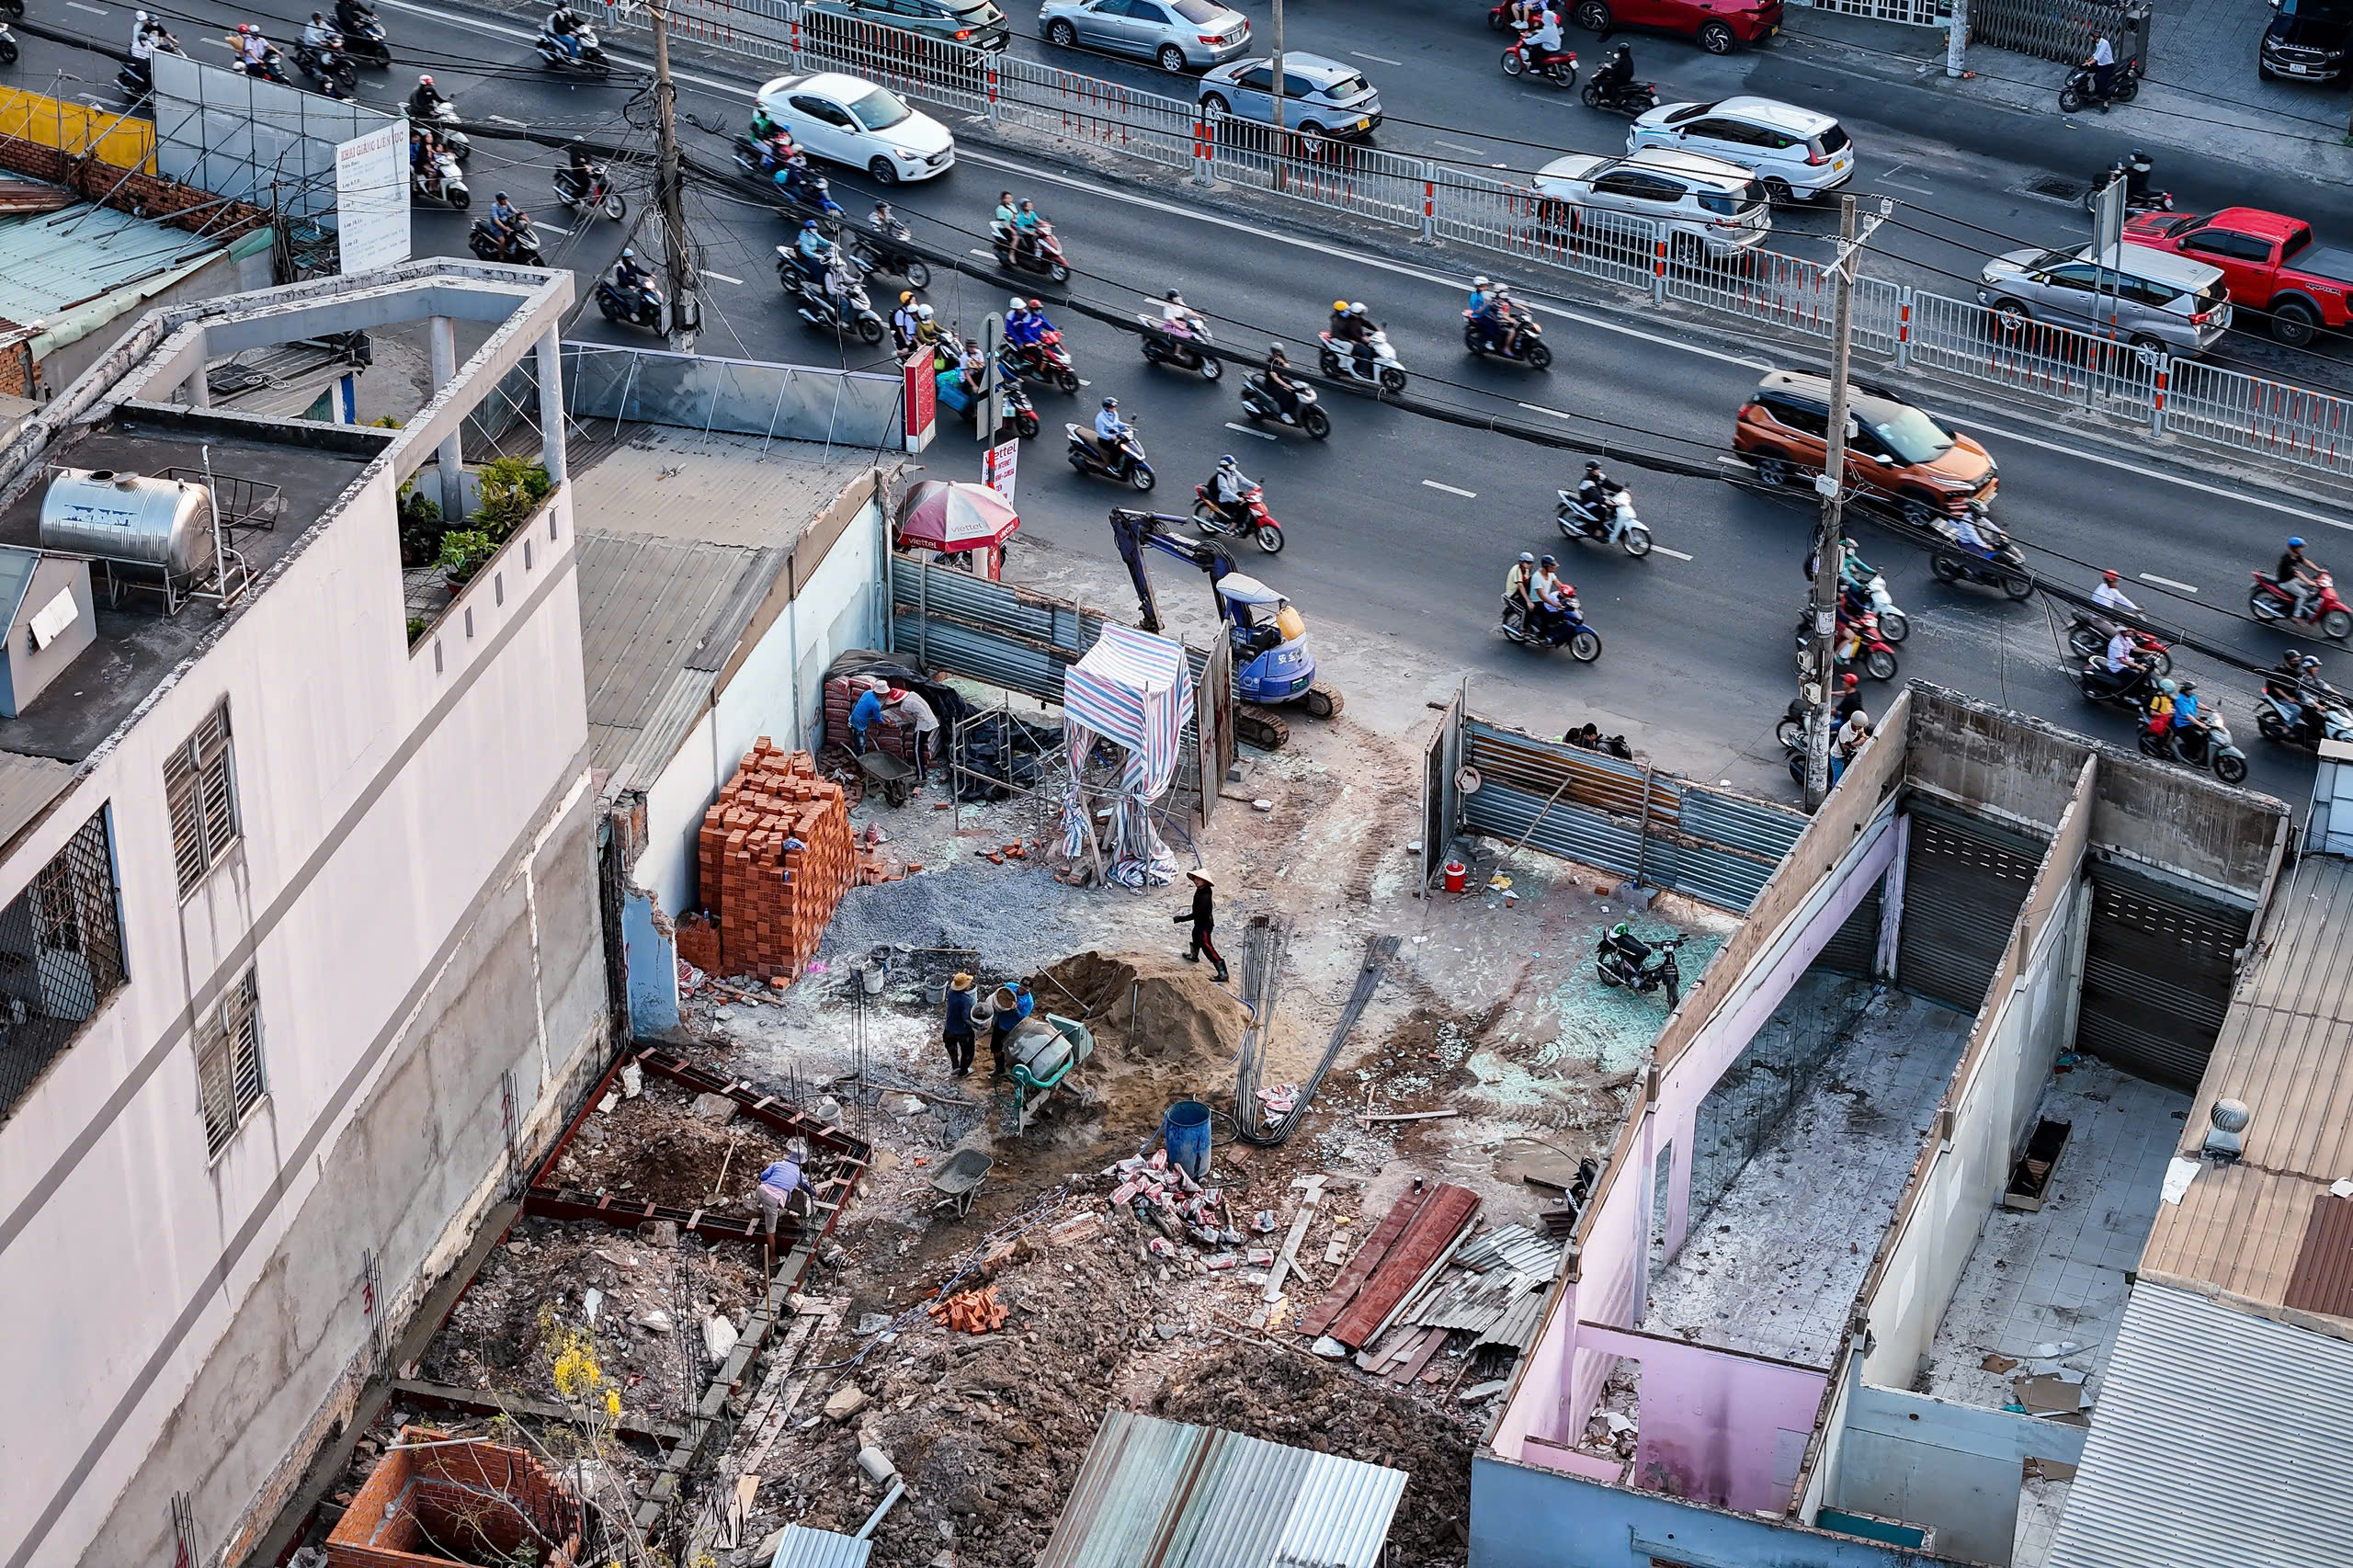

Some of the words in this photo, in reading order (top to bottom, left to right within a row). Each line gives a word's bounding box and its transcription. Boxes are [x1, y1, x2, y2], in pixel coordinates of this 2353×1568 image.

[341, 147, 356, 162] KHAI
[2305, 282, 2341, 297] RAPTOR
[985, 443, 1017, 465] vettel
[950, 522, 983, 534] viettel
[999, 522, 1016, 540] viettel
[908, 538, 938, 550] viettel
